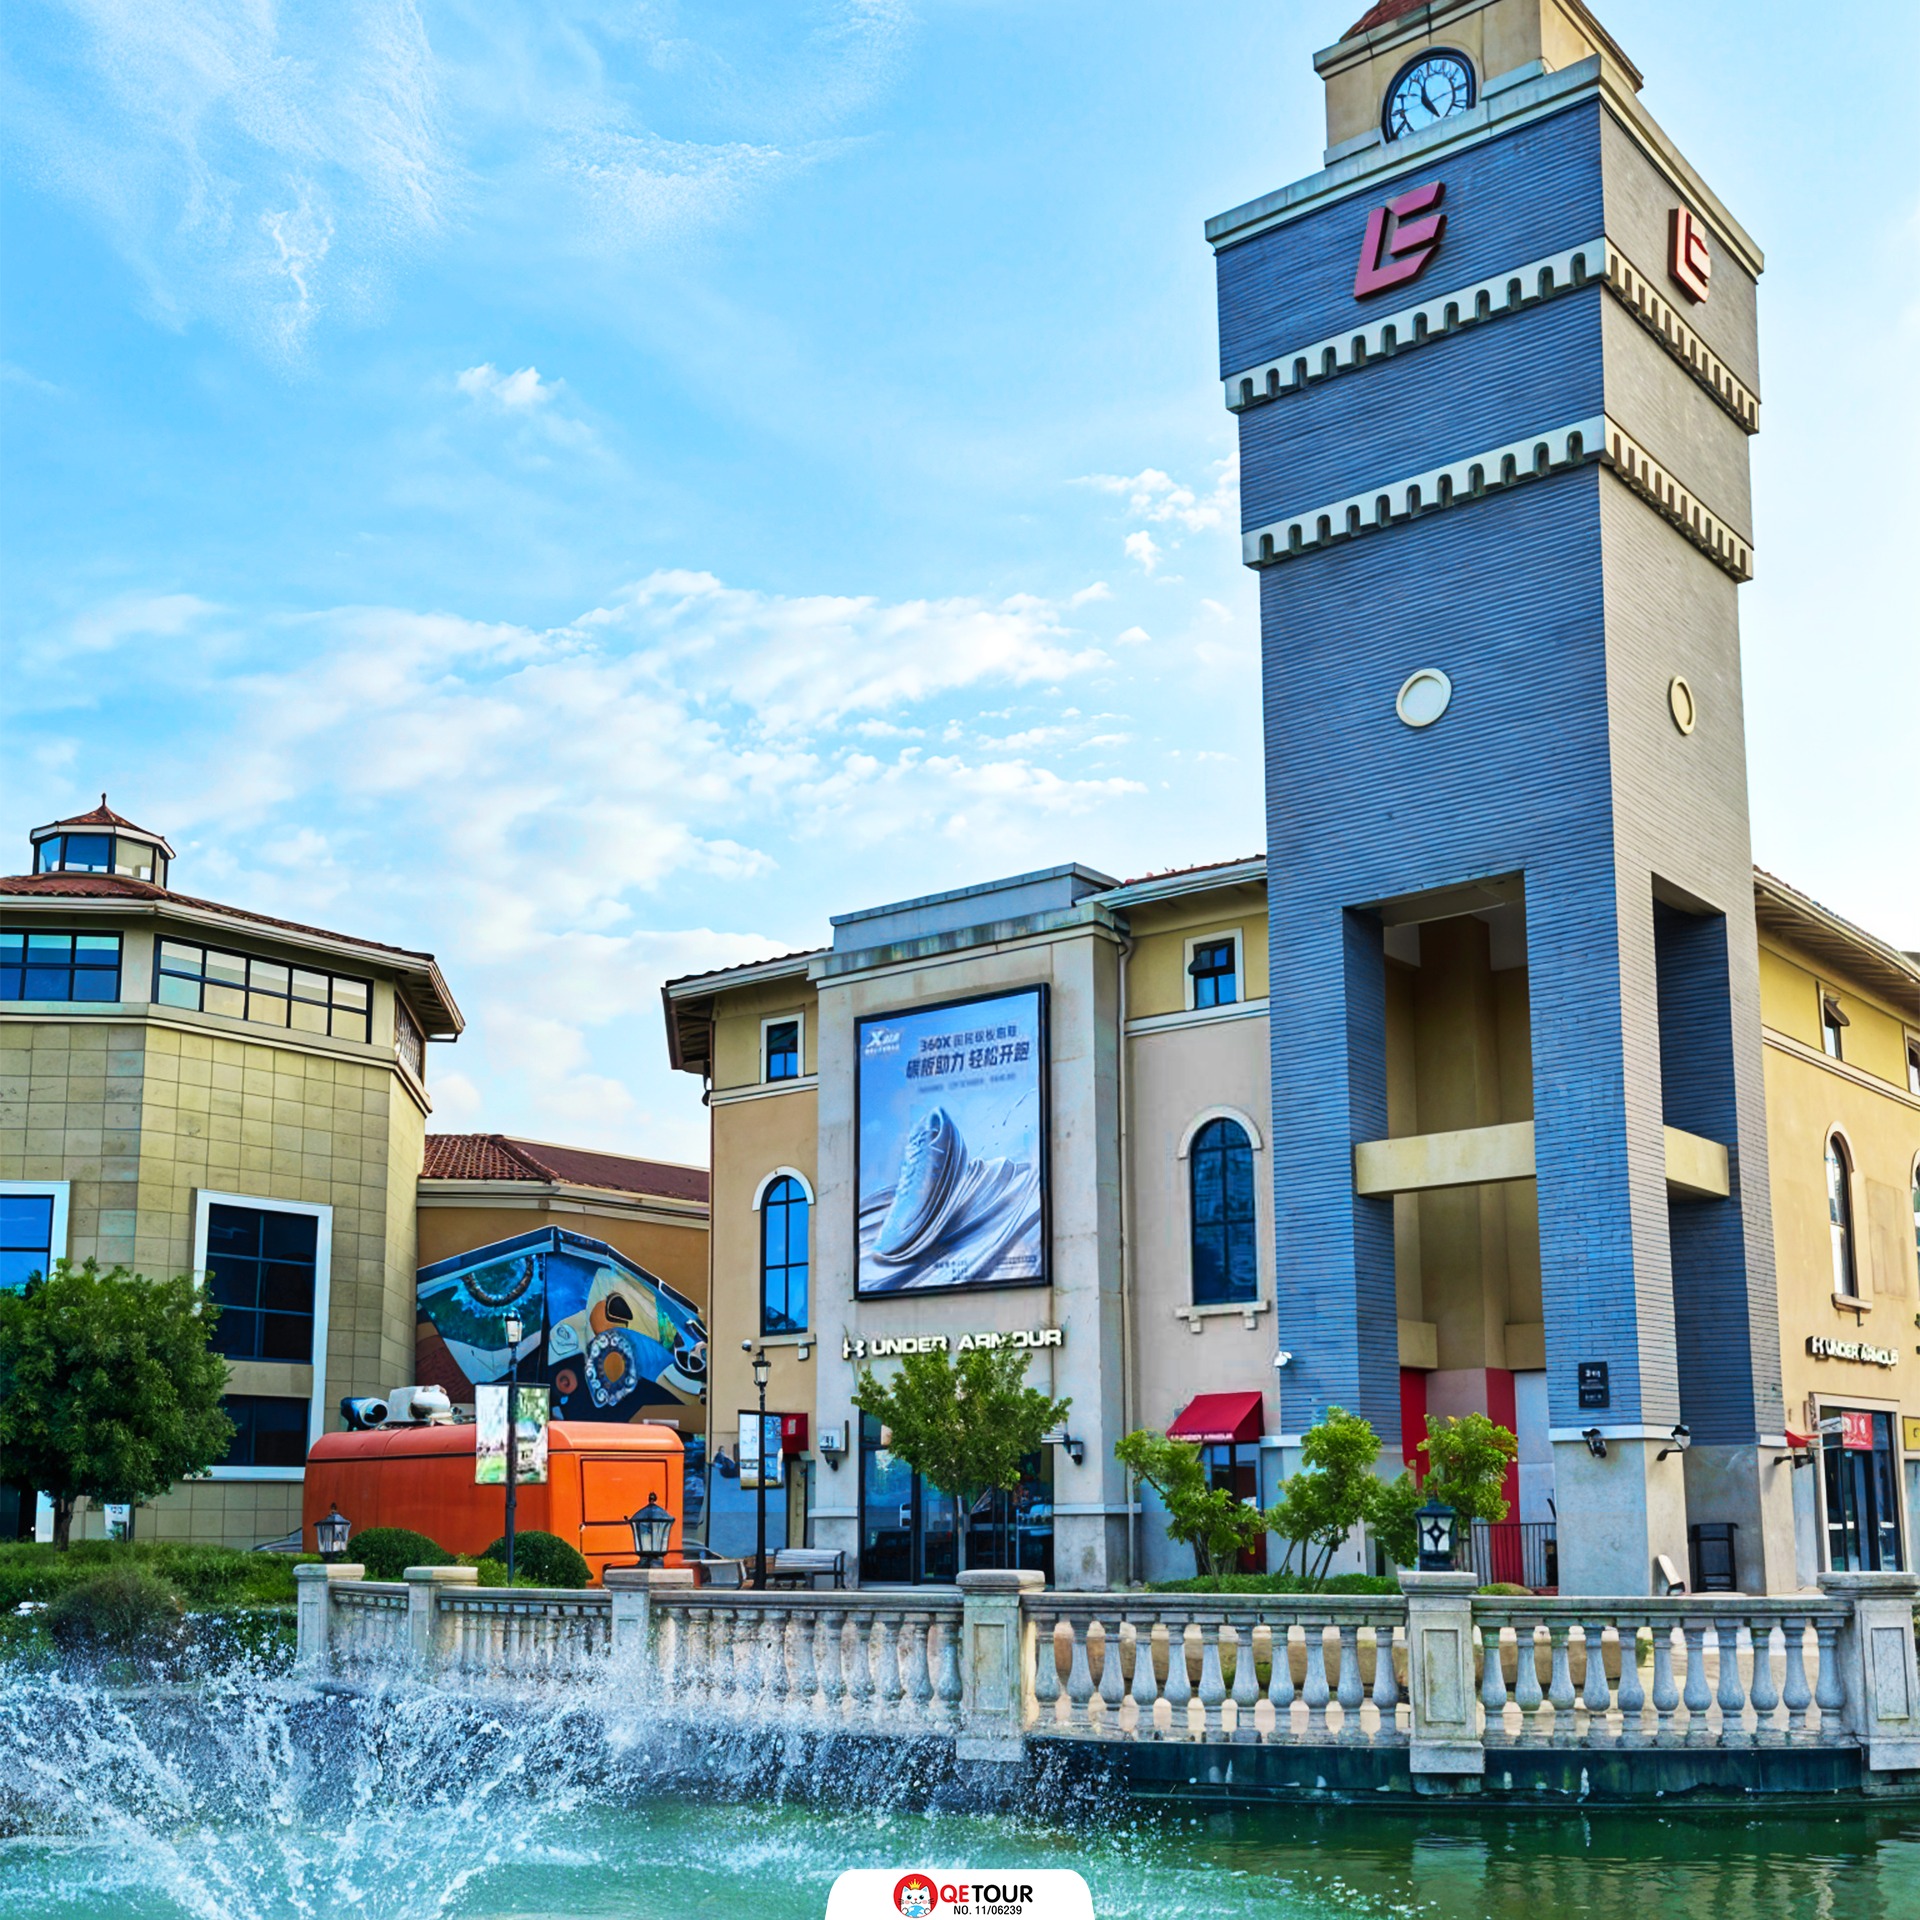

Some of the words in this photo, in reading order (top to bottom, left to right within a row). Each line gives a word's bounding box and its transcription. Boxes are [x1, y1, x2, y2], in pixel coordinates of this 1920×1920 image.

[920, 1035, 951, 1052] 360X
[969, 1041, 1030, 1069] 轻松开跑
[871, 1336, 948, 1356] UNDER
[957, 1329, 1062, 1351] ARMOUR
[1825, 1338, 1860, 1360] UNDER
